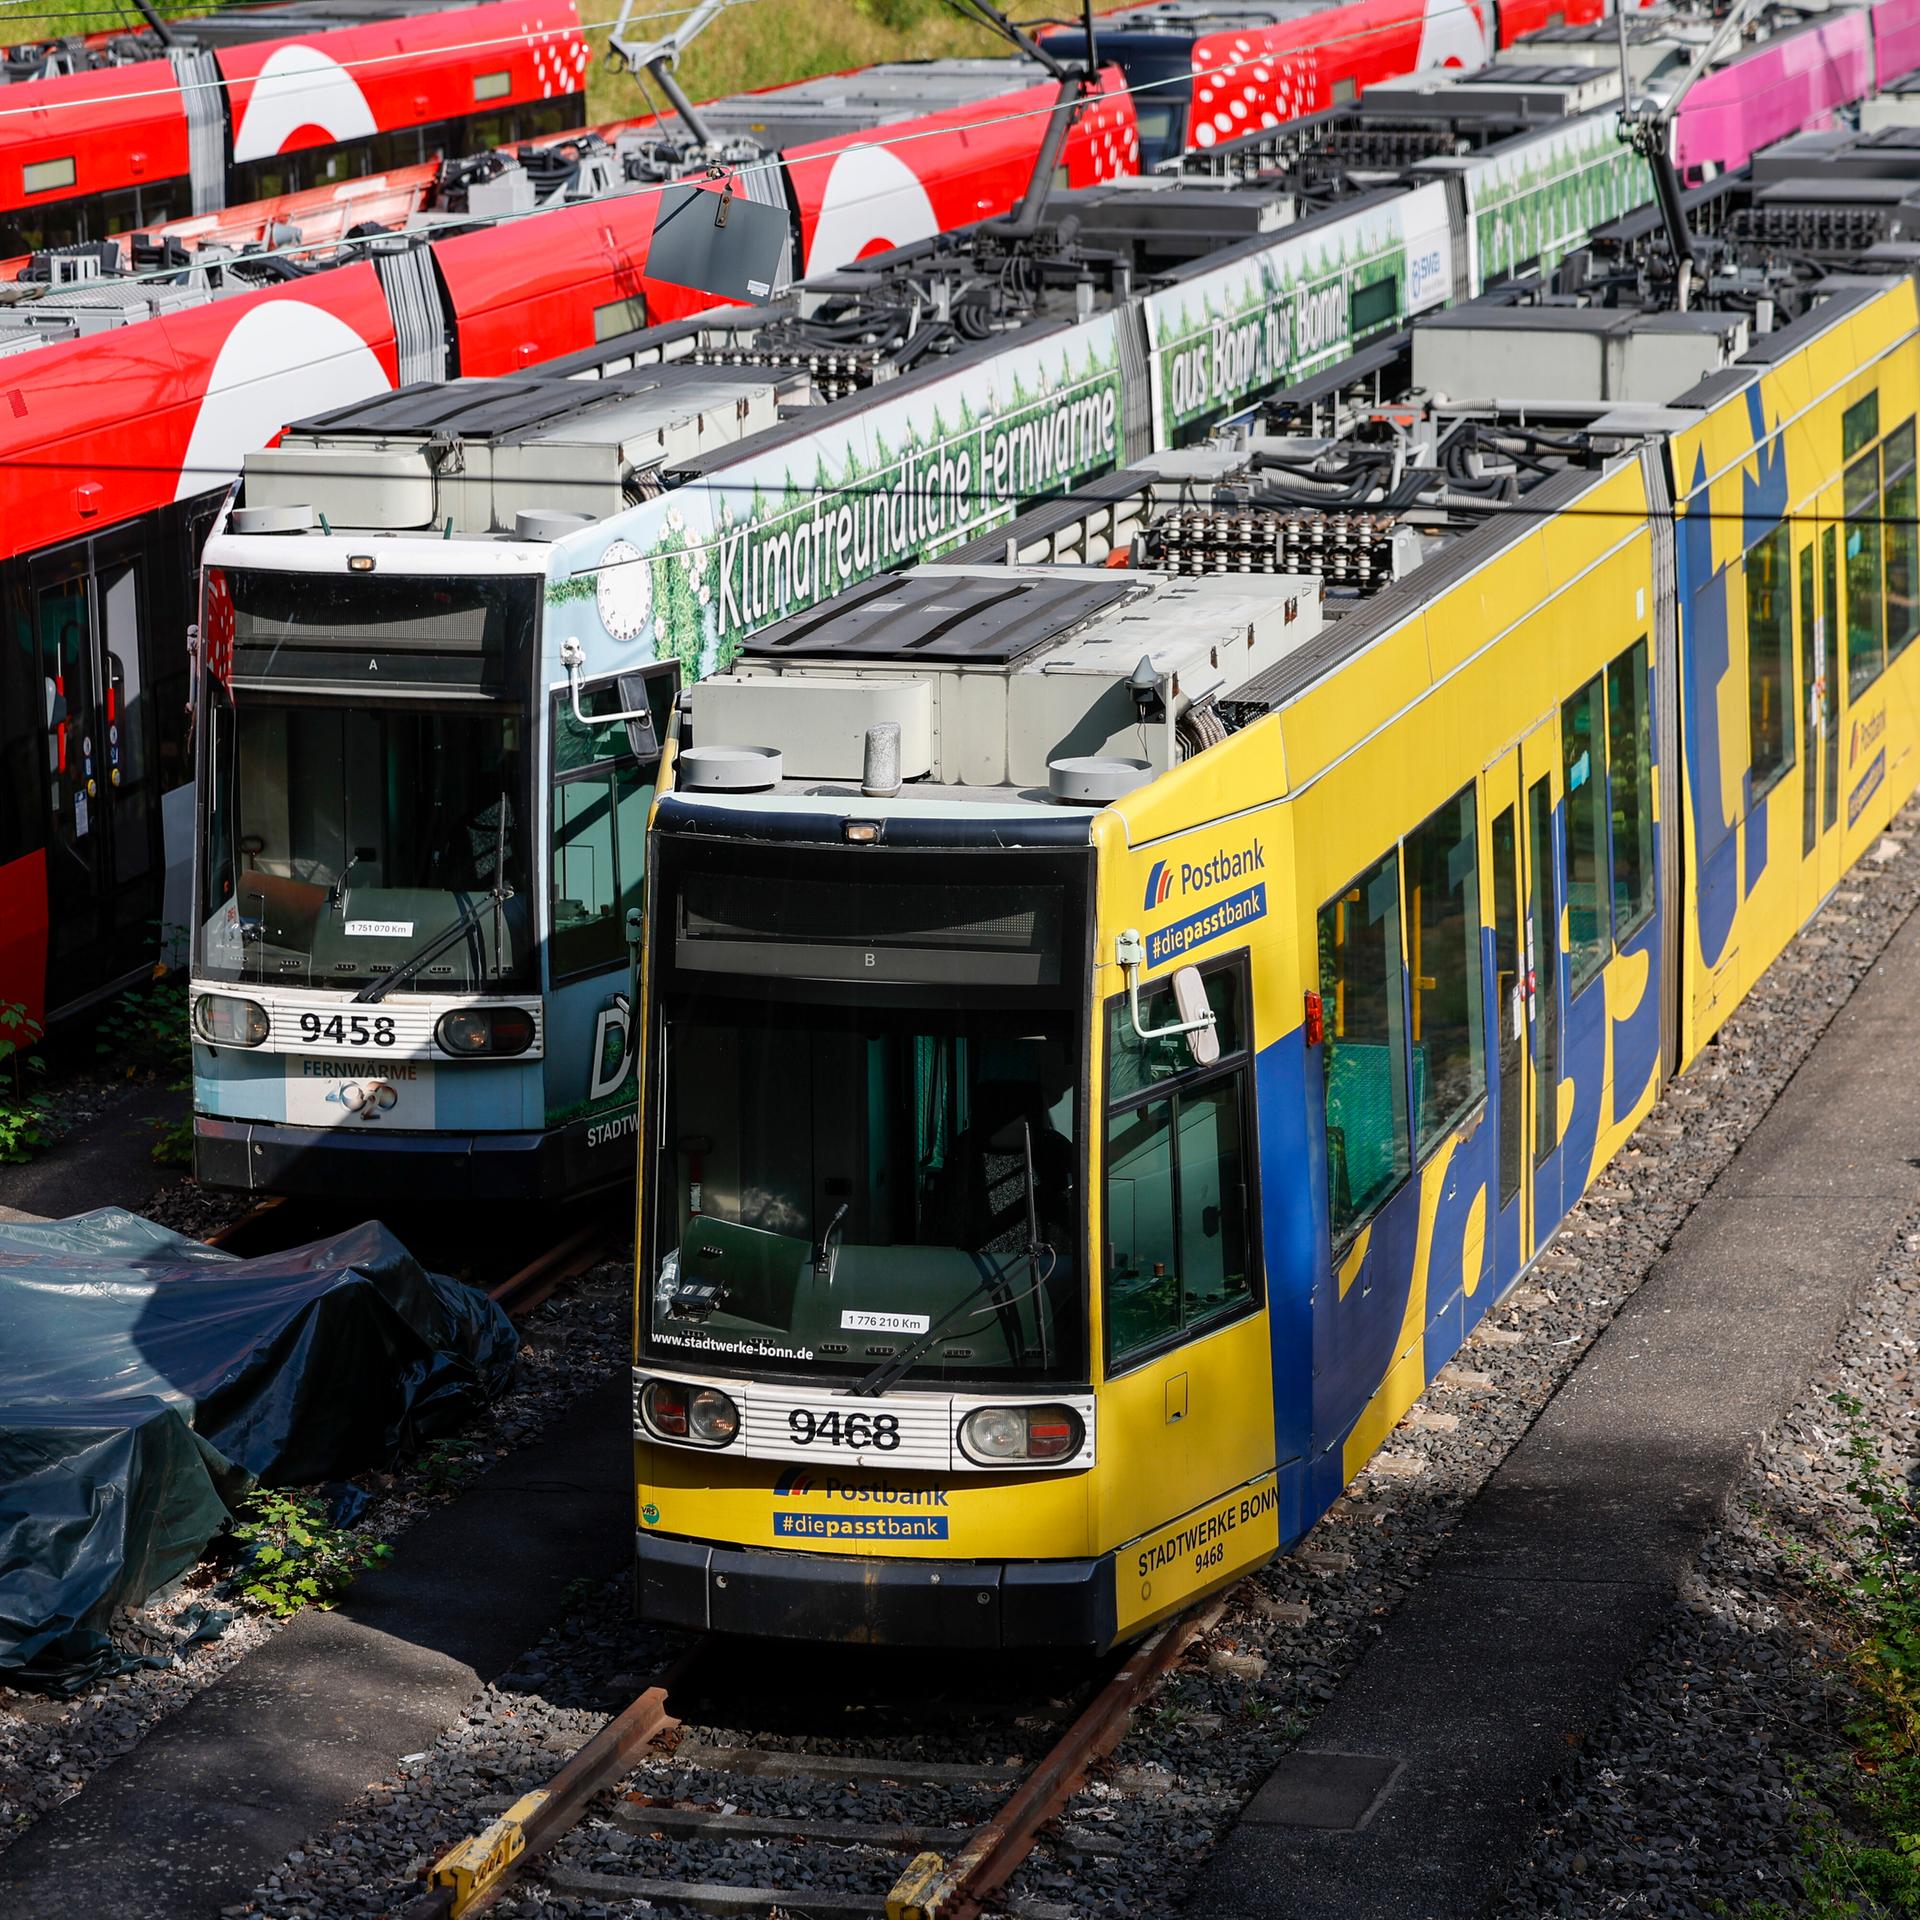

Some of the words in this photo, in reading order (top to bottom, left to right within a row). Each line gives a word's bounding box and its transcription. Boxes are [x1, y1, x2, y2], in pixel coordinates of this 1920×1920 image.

[1171, 345, 1208, 416] aus
[1211, 316, 1261, 398] Bonn
[1264, 291, 1294, 384] für
[1296, 262, 1348, 356] Bonn!
[717, 436, 971, 636] Klimafreundliche
[979, 385, 1115, 510] Fernwärme
[368, 658, 378, 670] A
[1181, 838, 1265, 895] Postbank
[351, 924, 356, 932] 1
[357, 924, 373, 932] 751
[374, 925, 390, 933] 070
[391, 925, 407, 934] Km
[1152, 889, 1261, 960] #diepasstbank
[865, 953, 876, 967] B
[300, 1013, 396, 1047] 9458
[303, 1060, 417, 1081] FERNWÄRME
[848, 1315, 854, 1324] 1
[856, 1315, 877, 1327] 776
[878, 1317, 900, 1328] 210
[902, 1318, 921, 1329] Km
[651, 1332, 814, 1360] www.stadtwerke-bonn.de
[788, 1408, 900, 1451] 9468
[826, 1477, 949, 1507] Postbank
[782, 1515, 939, 1537] #diepasstbank
[1138, 1506, 1237, 1577] STADTWERKE
[1240, 1486, 1280, 1524] BONN
[1195, 1542, 1224, 1574] 9468
